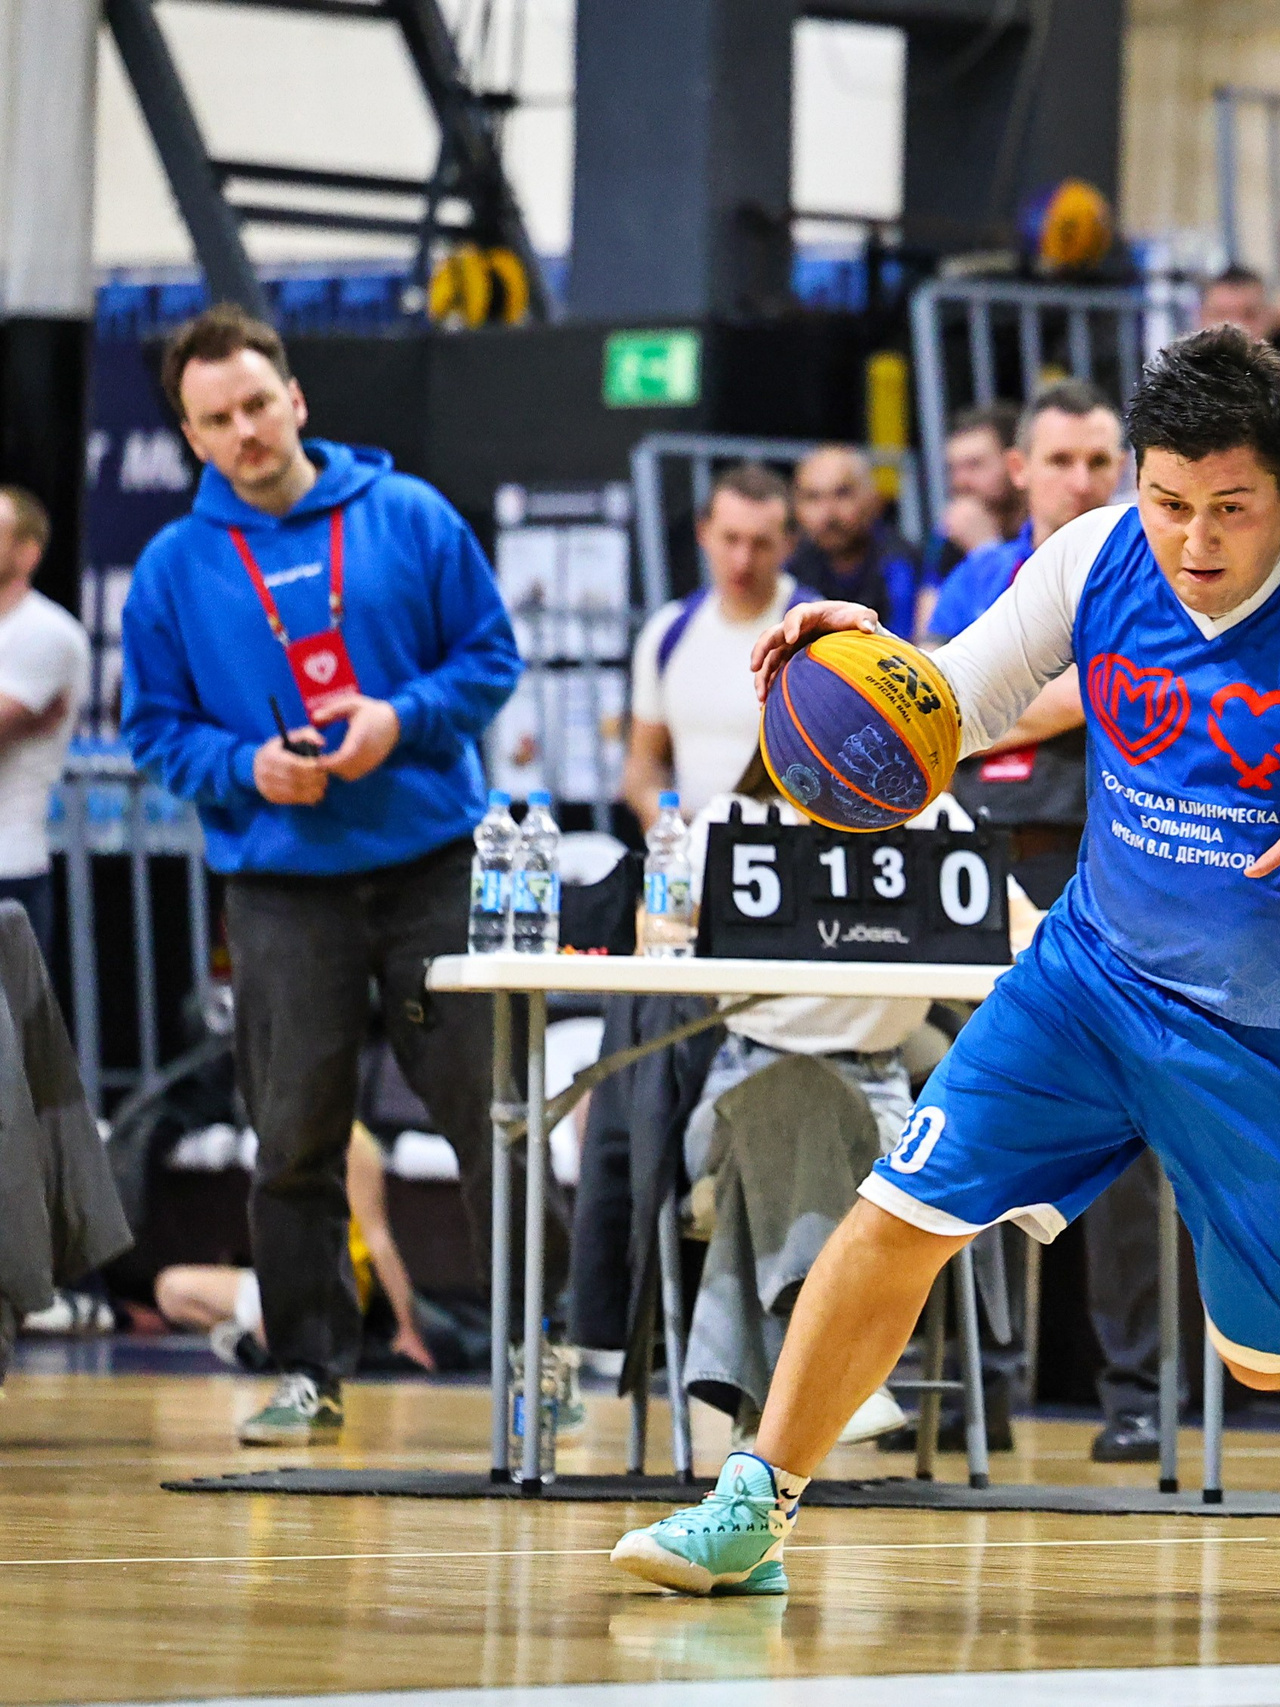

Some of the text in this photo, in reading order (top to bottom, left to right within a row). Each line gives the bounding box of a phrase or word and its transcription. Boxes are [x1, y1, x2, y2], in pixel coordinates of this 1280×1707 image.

[865, 675, 912, 724] OFFICIAL BALL
[1111, 818, 1256, 870] ИМЕНИ В.П. ДЕМИХОВ
[1139, 815, 1223, 844] БОЛЬНИЦА
[732, 844, 781, 918] 5
[939, 850, 990, 925] 0
